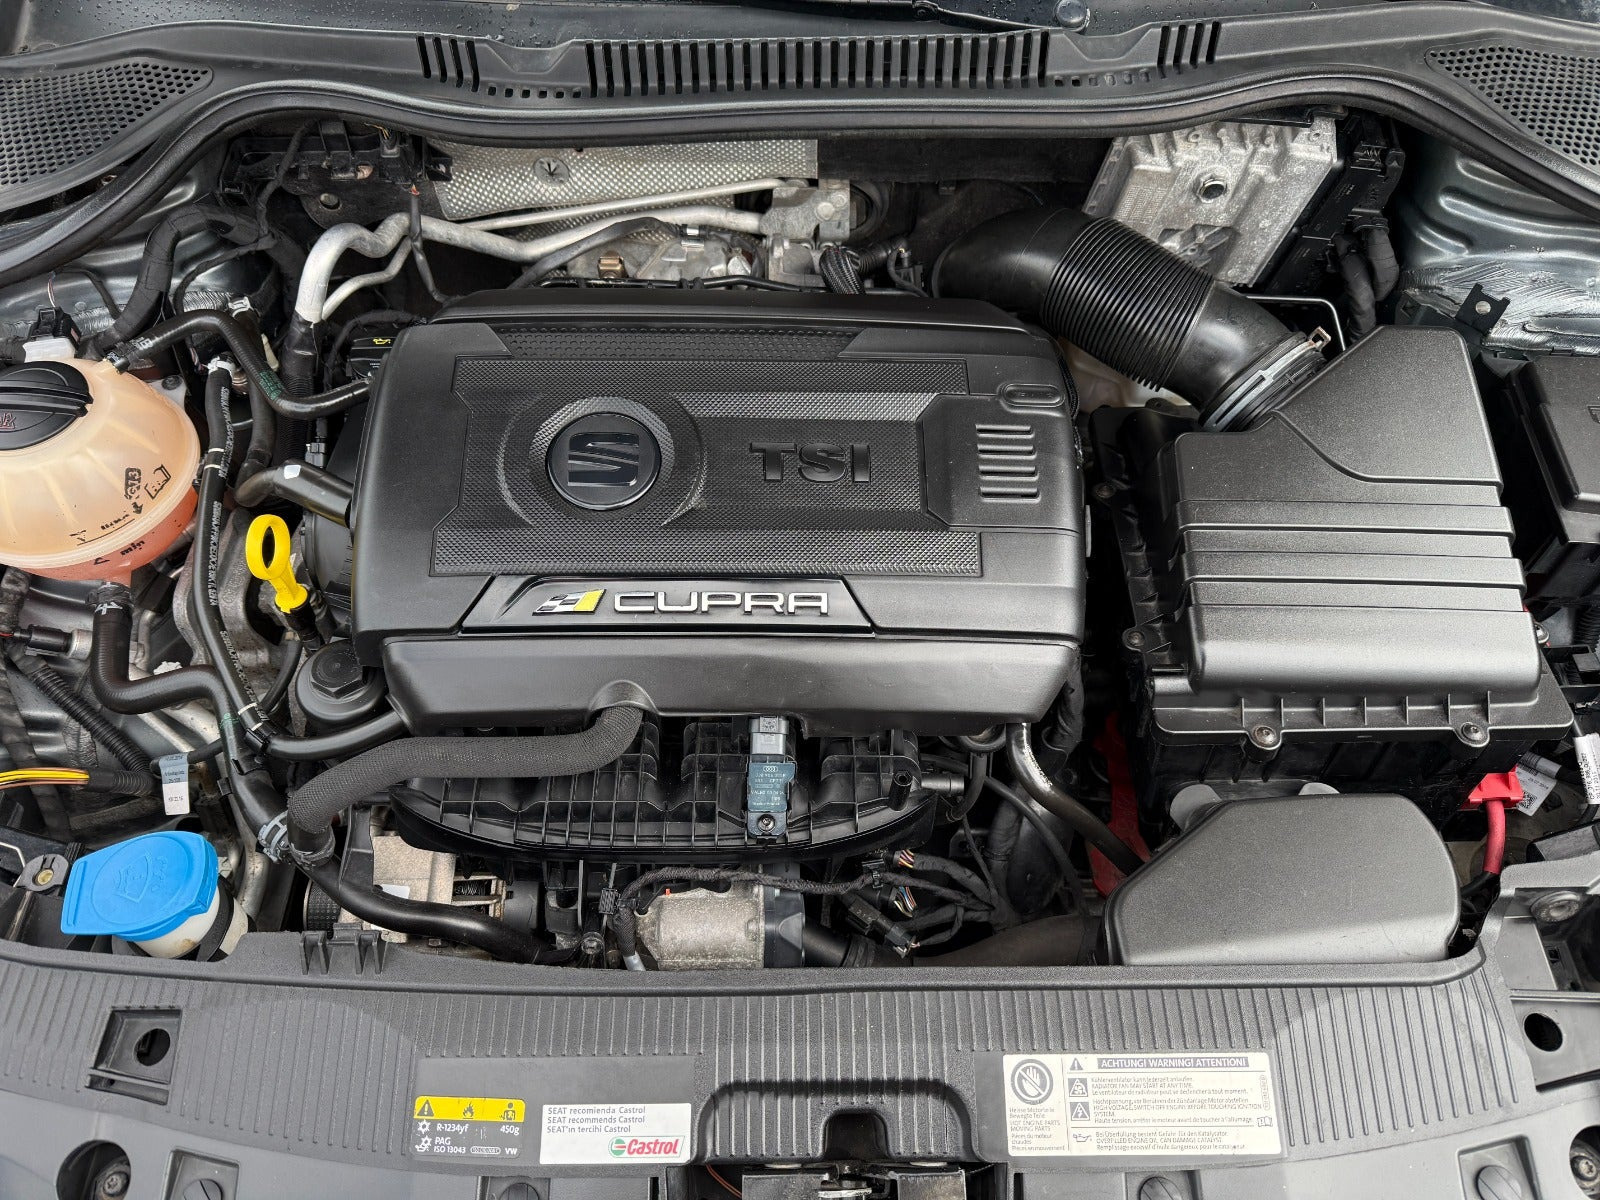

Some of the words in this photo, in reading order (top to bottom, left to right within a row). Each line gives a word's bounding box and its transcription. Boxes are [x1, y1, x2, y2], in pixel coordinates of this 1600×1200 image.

[749, 441, 871, 483] TSI
[613, 591, 829, 616] CUPRA
[1101, 1059, 1146, 1068] ACHTUNG!
[1148, 1058, 1193, 1068] WARNING!
[1195, 1058, 1246, 1067] ATTENTION!
[548, 1107, 567, 1115] SEAT
[618, 1106, 646, 1114] Castrol
[547, 1116, 567, 1124] SEAT
[618, 1115, 645, 1123] Castrol
[436, 1123, 470, 1134] R-1234yf
[500, 1125, 520, 1135] 450g
[577, 1125, 602, 1133] tercihi
[604, 1125, 631, 1133] Castrol
[434, 1136, 451, 1145] PAG
[447, 1146, 466, 1154] 13043
[504, 1147, 518, 1155] VW
[627, 1138, 679, 1155] Castrol
